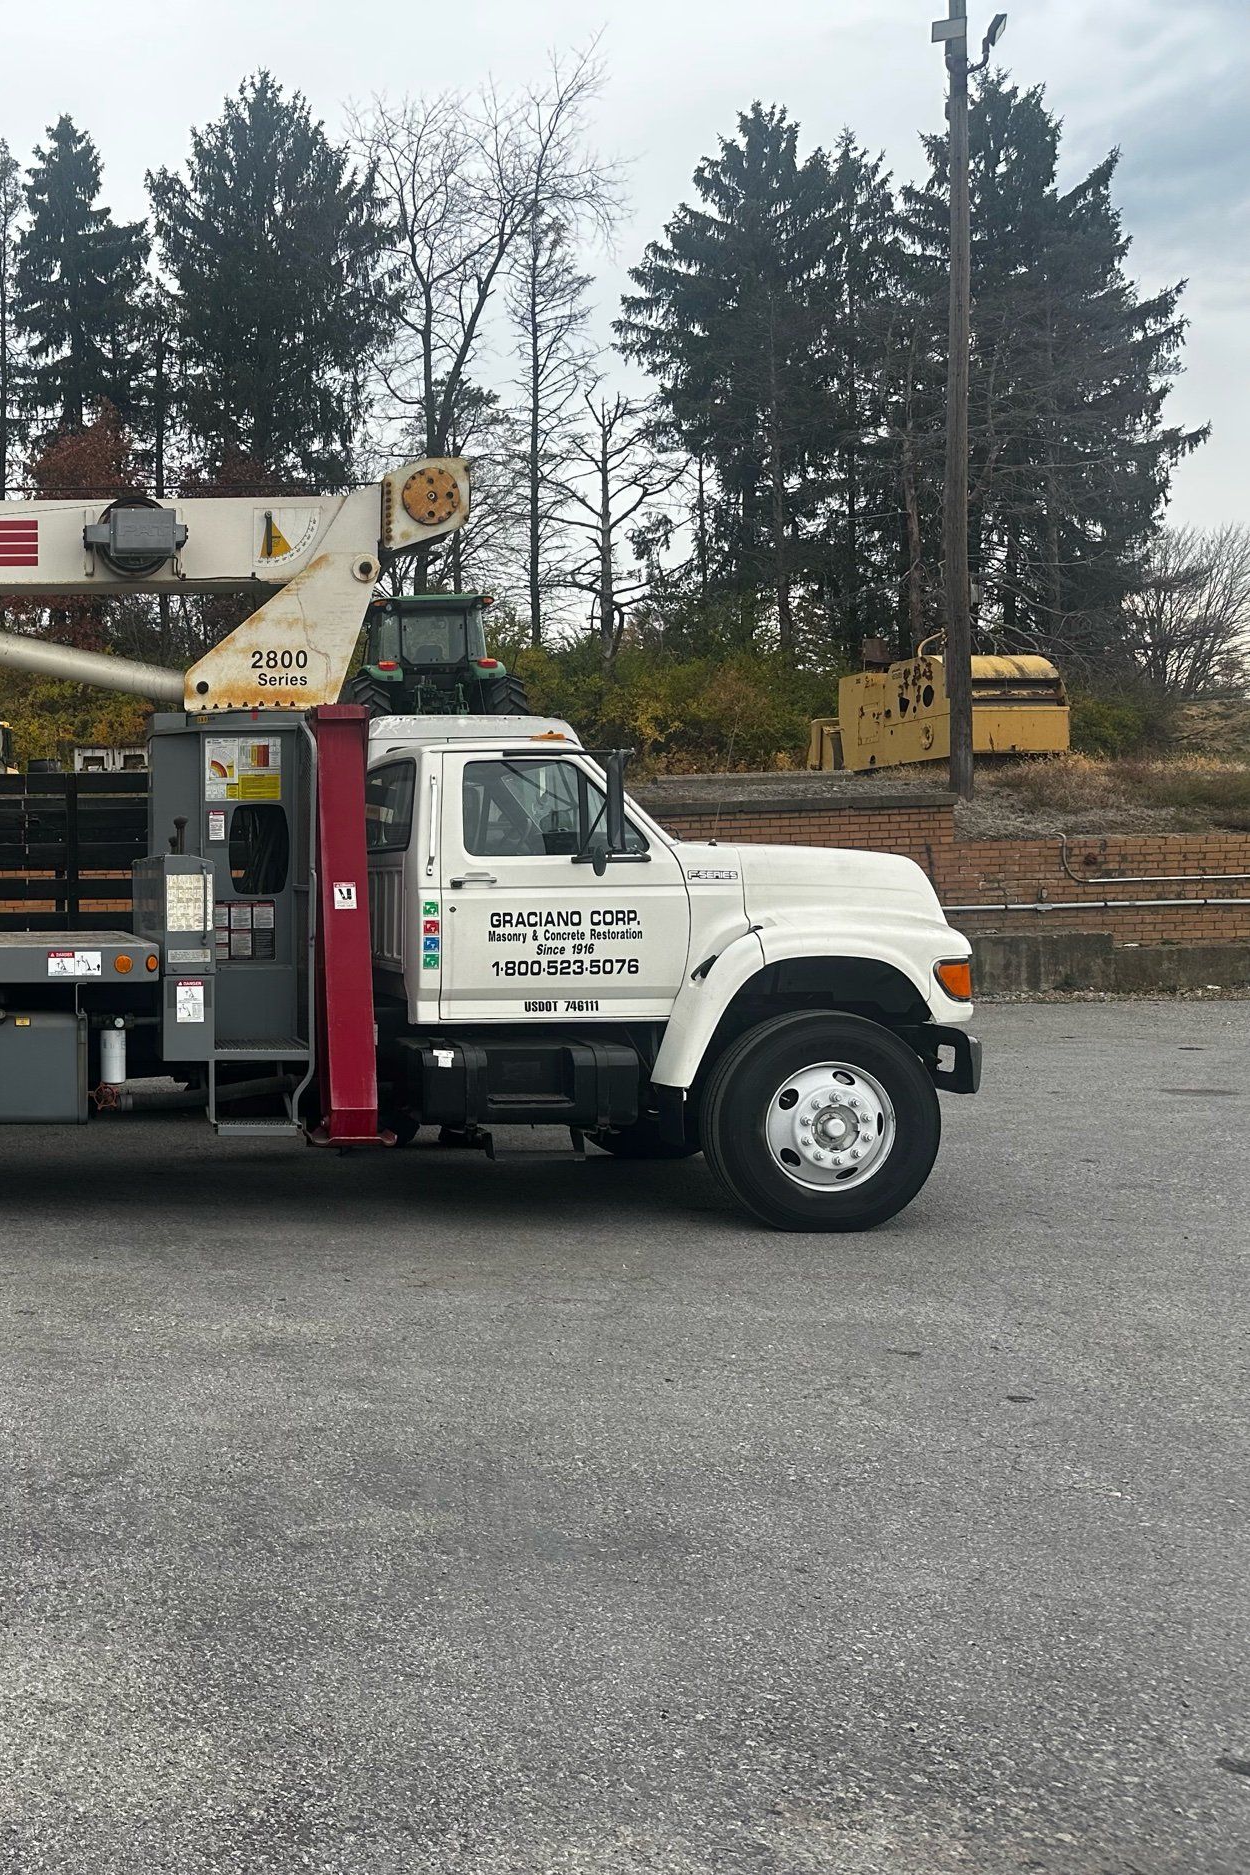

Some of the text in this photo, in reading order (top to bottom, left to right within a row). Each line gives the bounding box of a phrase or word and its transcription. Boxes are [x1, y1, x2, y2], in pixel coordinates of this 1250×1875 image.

[251, 649, 308, 669] 2800
[257, 672, 308, 687] Series
[490, 909, 641, 929] GRACIANO CORP.
[488, 927, 643, 944] Masonry & Concrete Restoration
[536, 942, 595, 956] Since 1916
[524, 1000, 599, 1013] USDOT 746111
